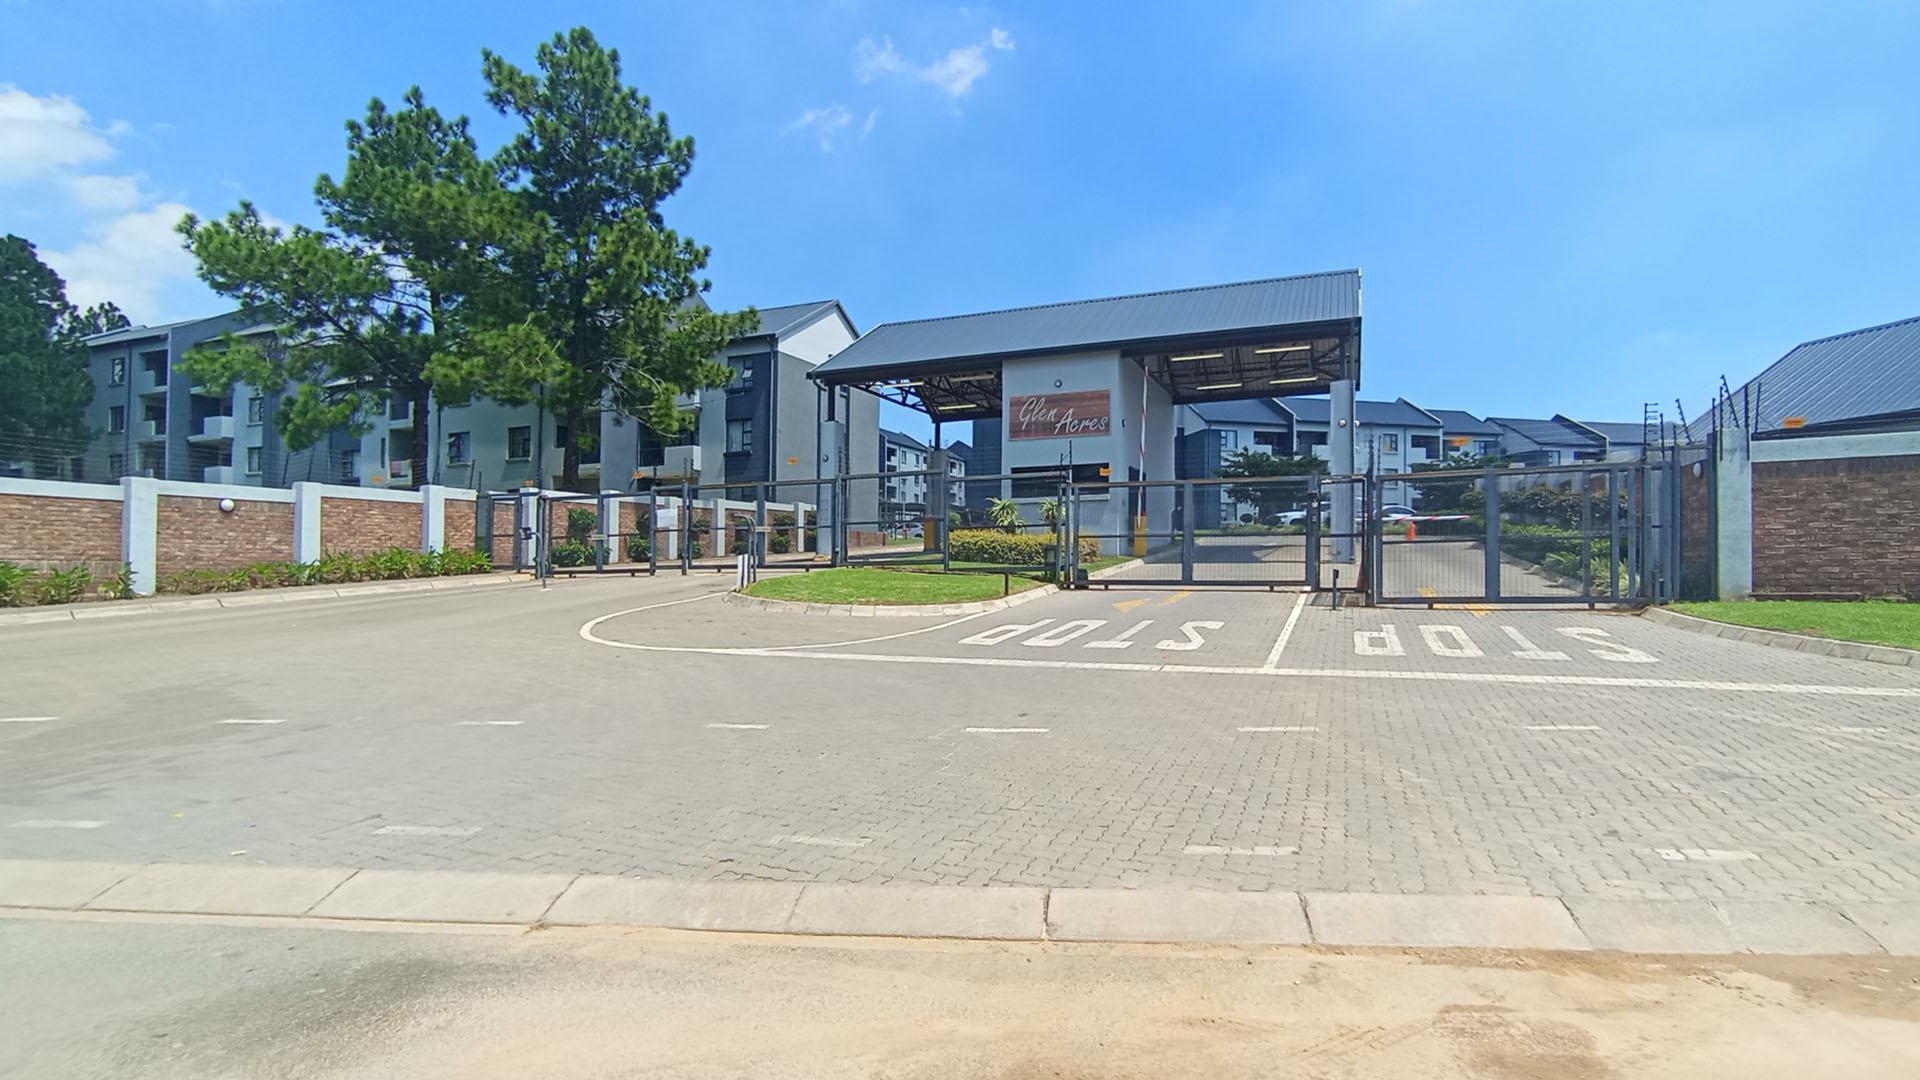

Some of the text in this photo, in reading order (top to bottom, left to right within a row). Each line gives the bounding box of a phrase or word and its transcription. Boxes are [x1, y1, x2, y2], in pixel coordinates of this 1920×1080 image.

[1019, 397, 1109, 434] Glen Acres
[958, 618, 1225, 651] STOP
[1353, 623, 1661, 663] STOP
